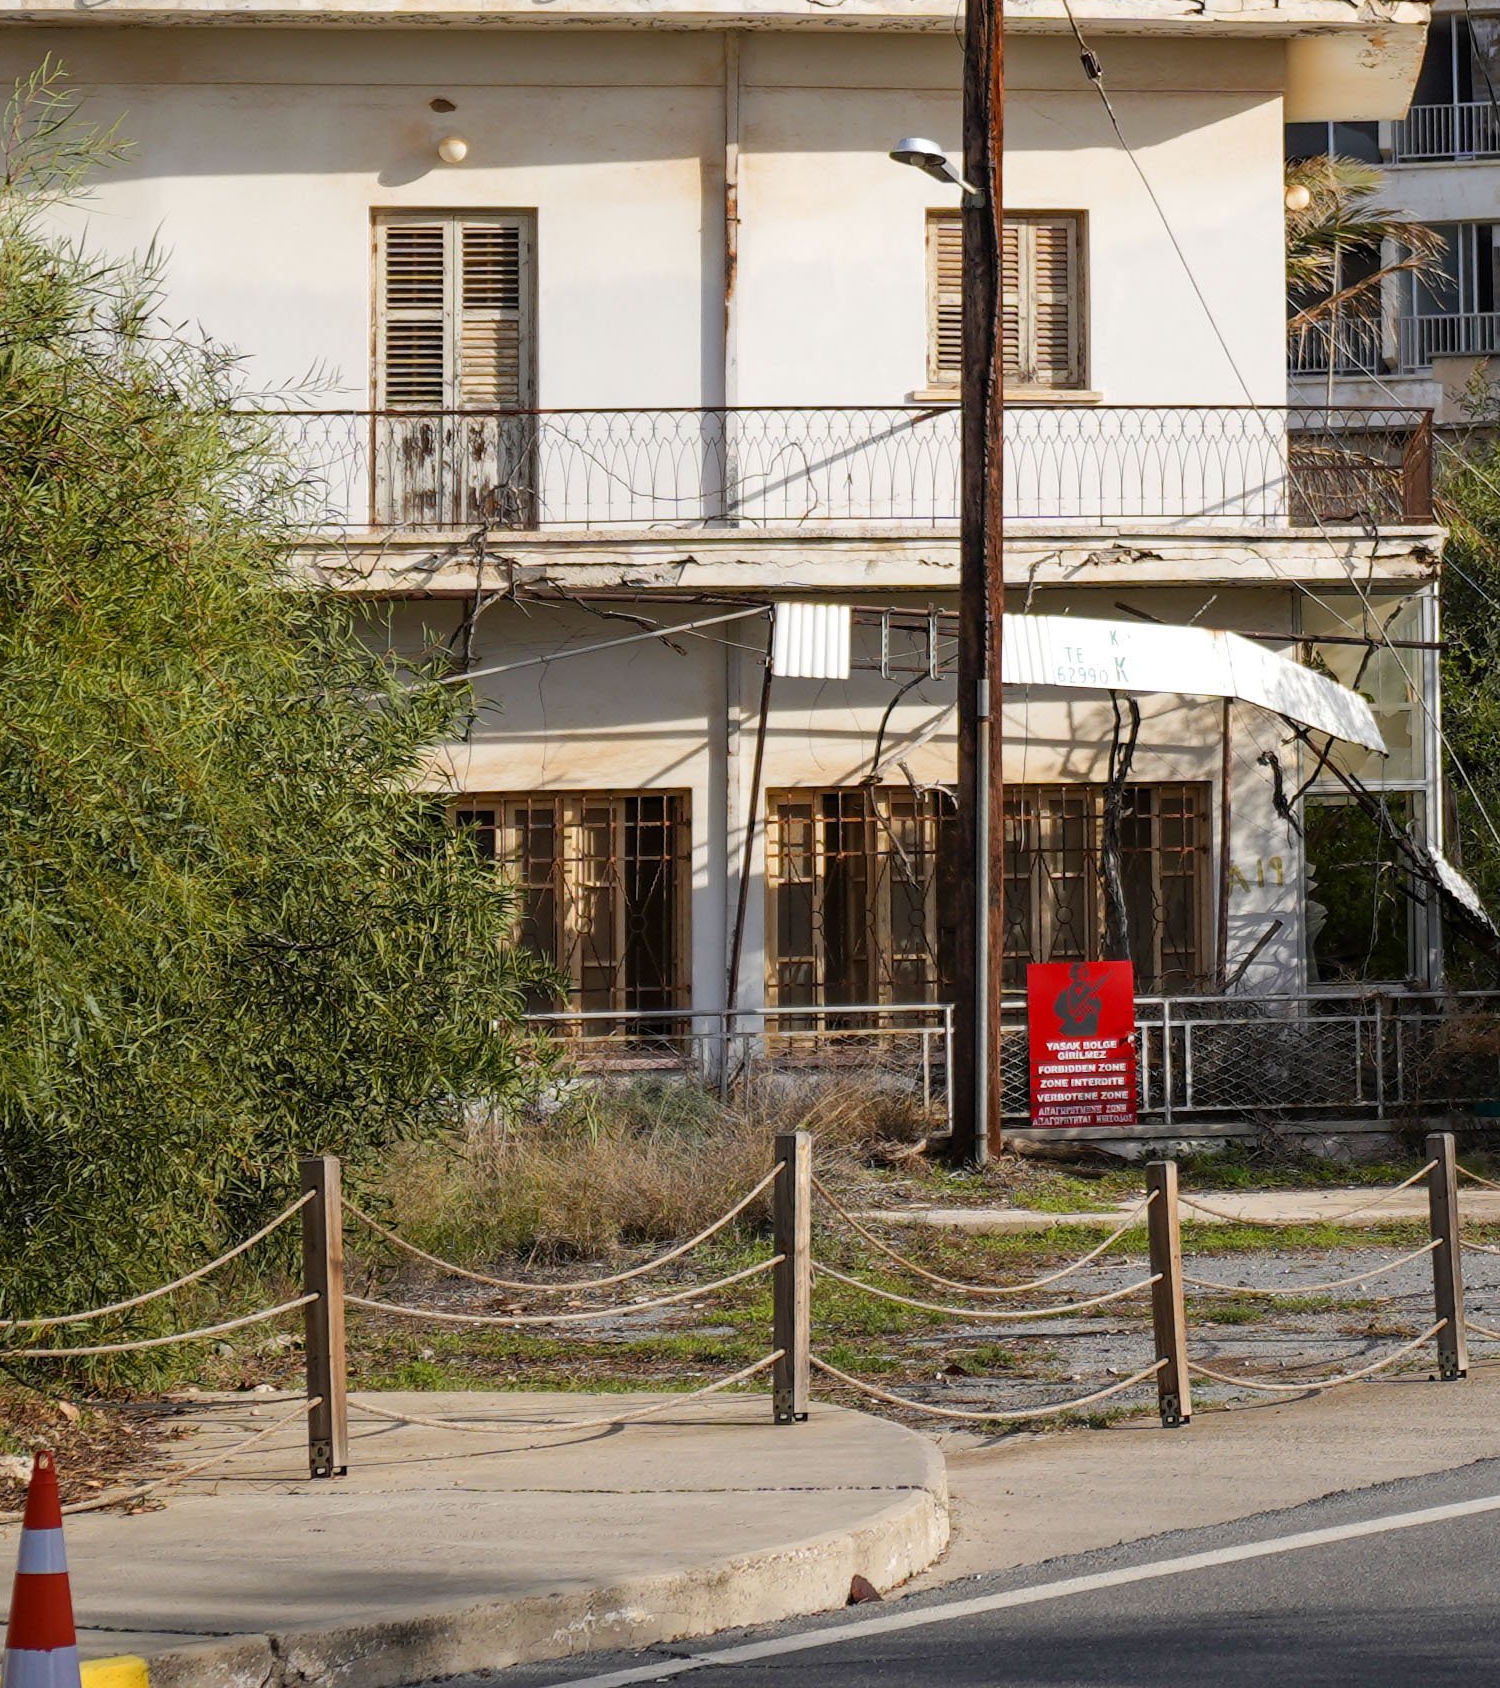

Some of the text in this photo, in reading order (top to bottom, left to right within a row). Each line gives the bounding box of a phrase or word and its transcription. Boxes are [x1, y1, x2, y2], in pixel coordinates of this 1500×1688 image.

[1056, 667, 1109, 685] 62990
[1046, 1041, 1081, 1051] YASAK
[1038, 1063, 1127, 1075] FORBIDDEN ZONE
[1040, 1077, 1125, 1088] ZONE INTERDITE
[1037, 1091, 1129, 1103] VERBOTENE ZONE
